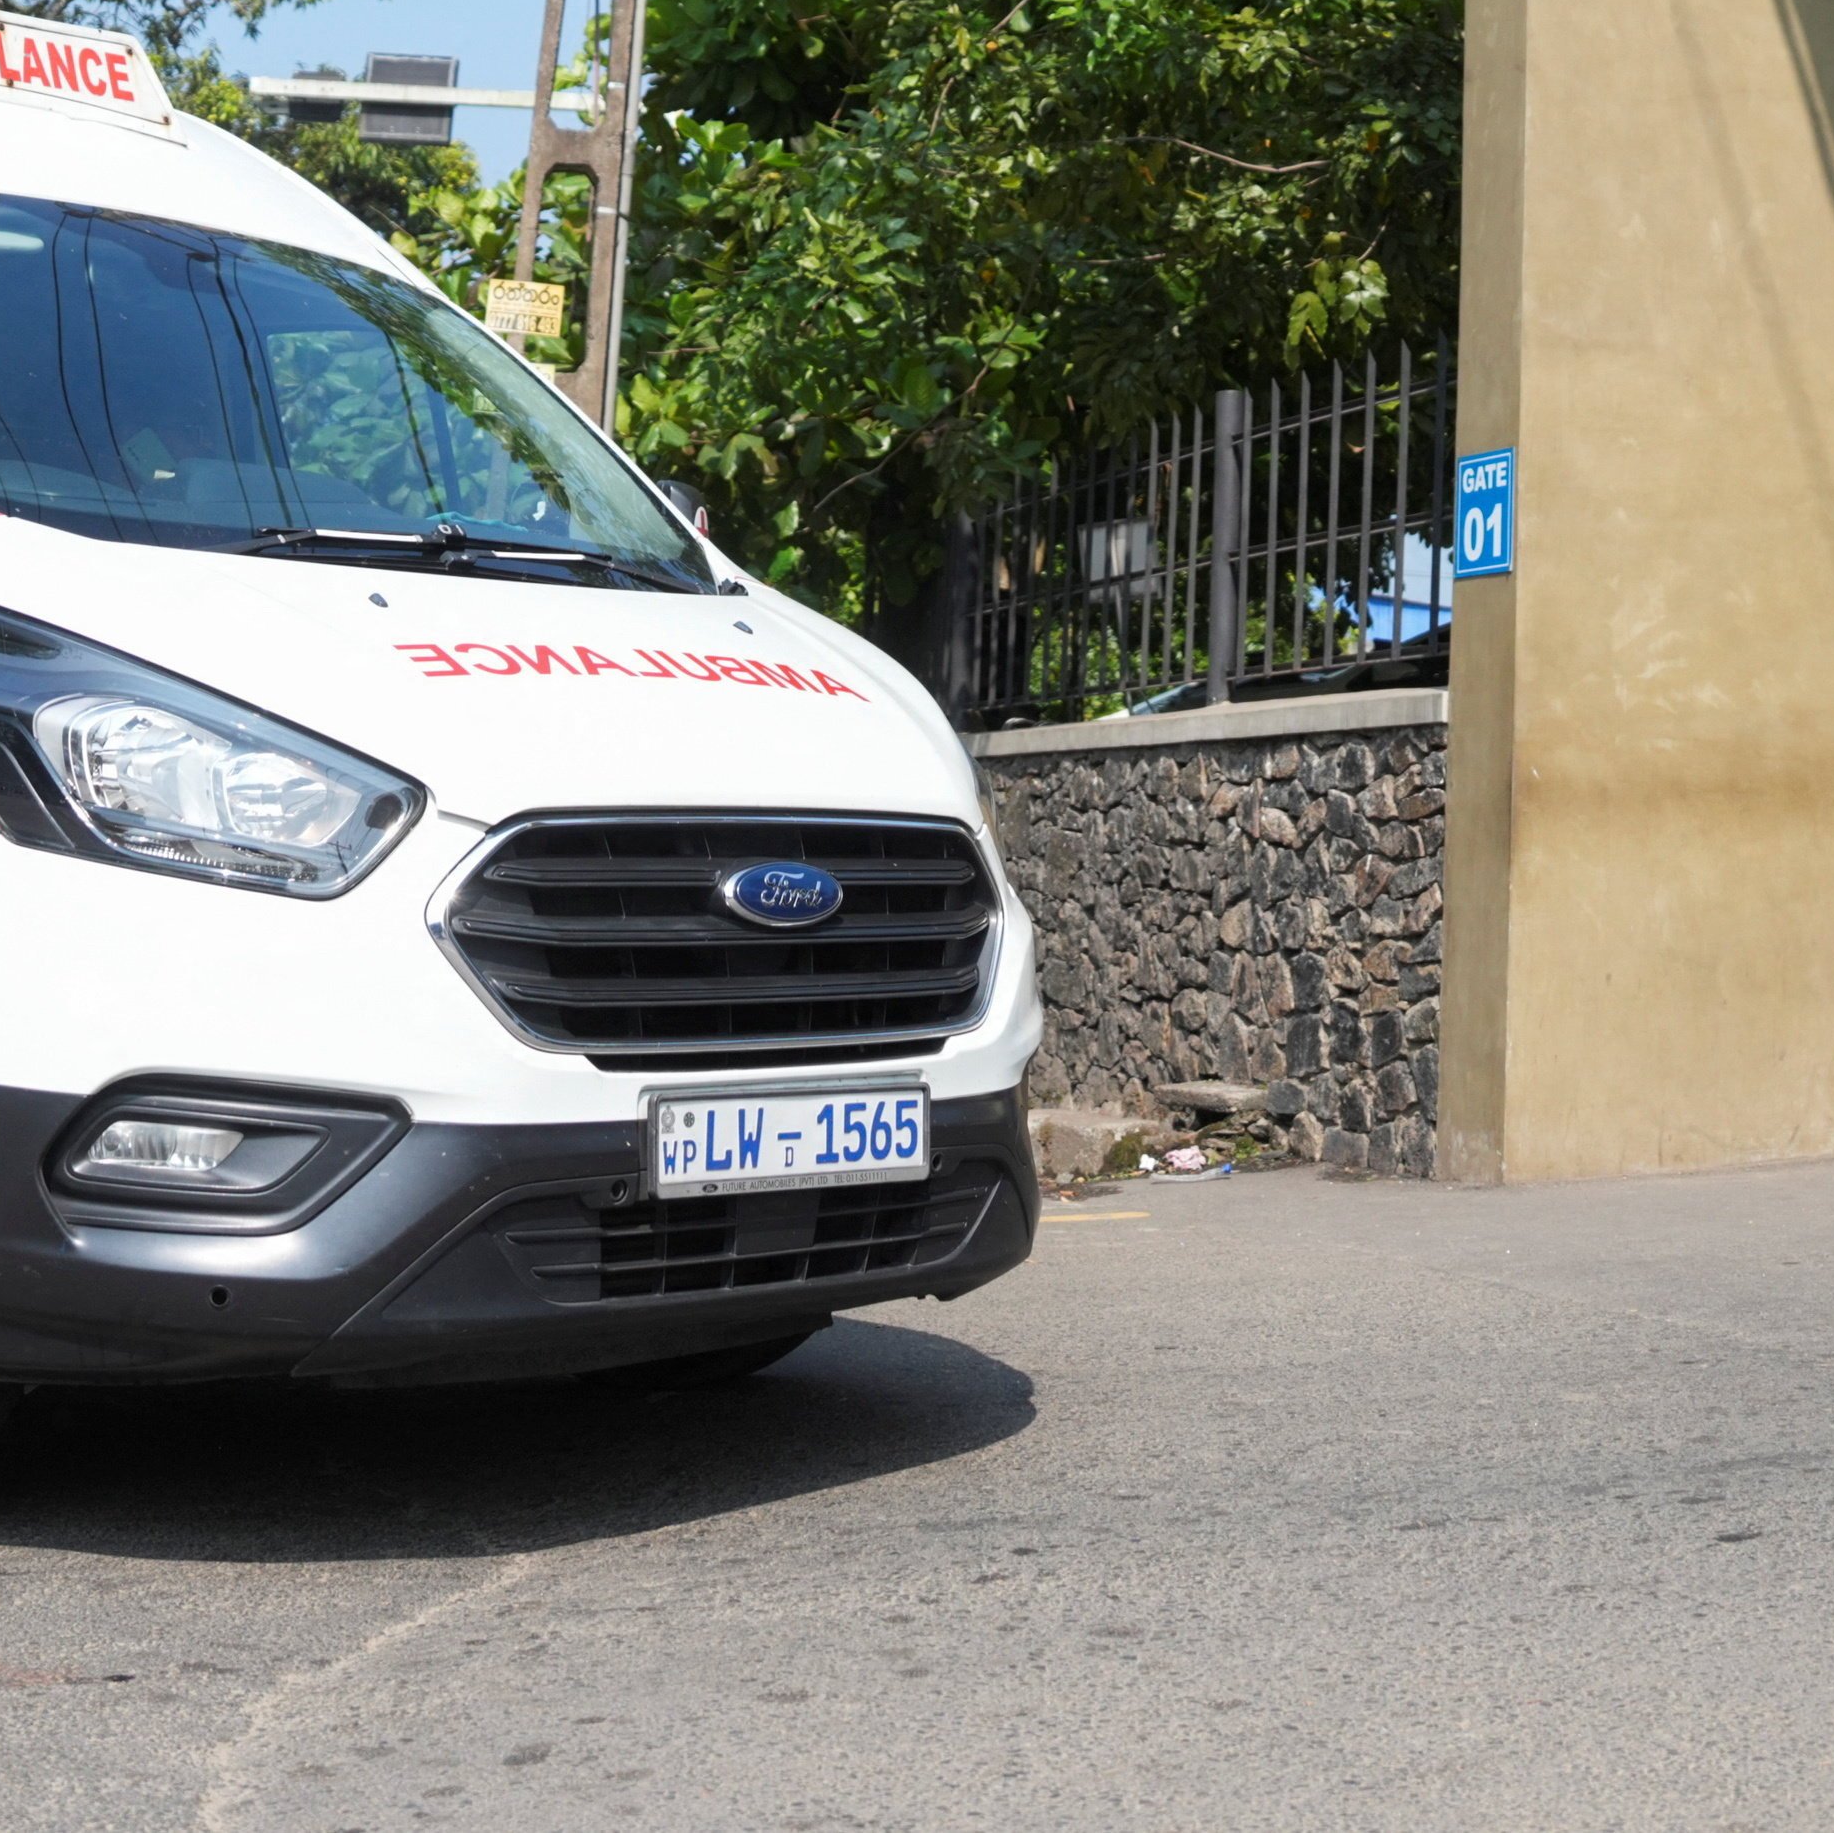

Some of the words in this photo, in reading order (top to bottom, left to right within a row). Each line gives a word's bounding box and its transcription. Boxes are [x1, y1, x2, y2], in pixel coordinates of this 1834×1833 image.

[1462, 461, 1507, 493] GATE
[1464, 503, 1502, 562] 01
[760, 871, 822, 909] Ford
[663, 1139, 697, 1174] WP
[722, 1183, 746, 1192] FUTURE
[749, 1178, 796, 1191] AUTOMOBILES
[817, 1175, 828, 1185] LTD
